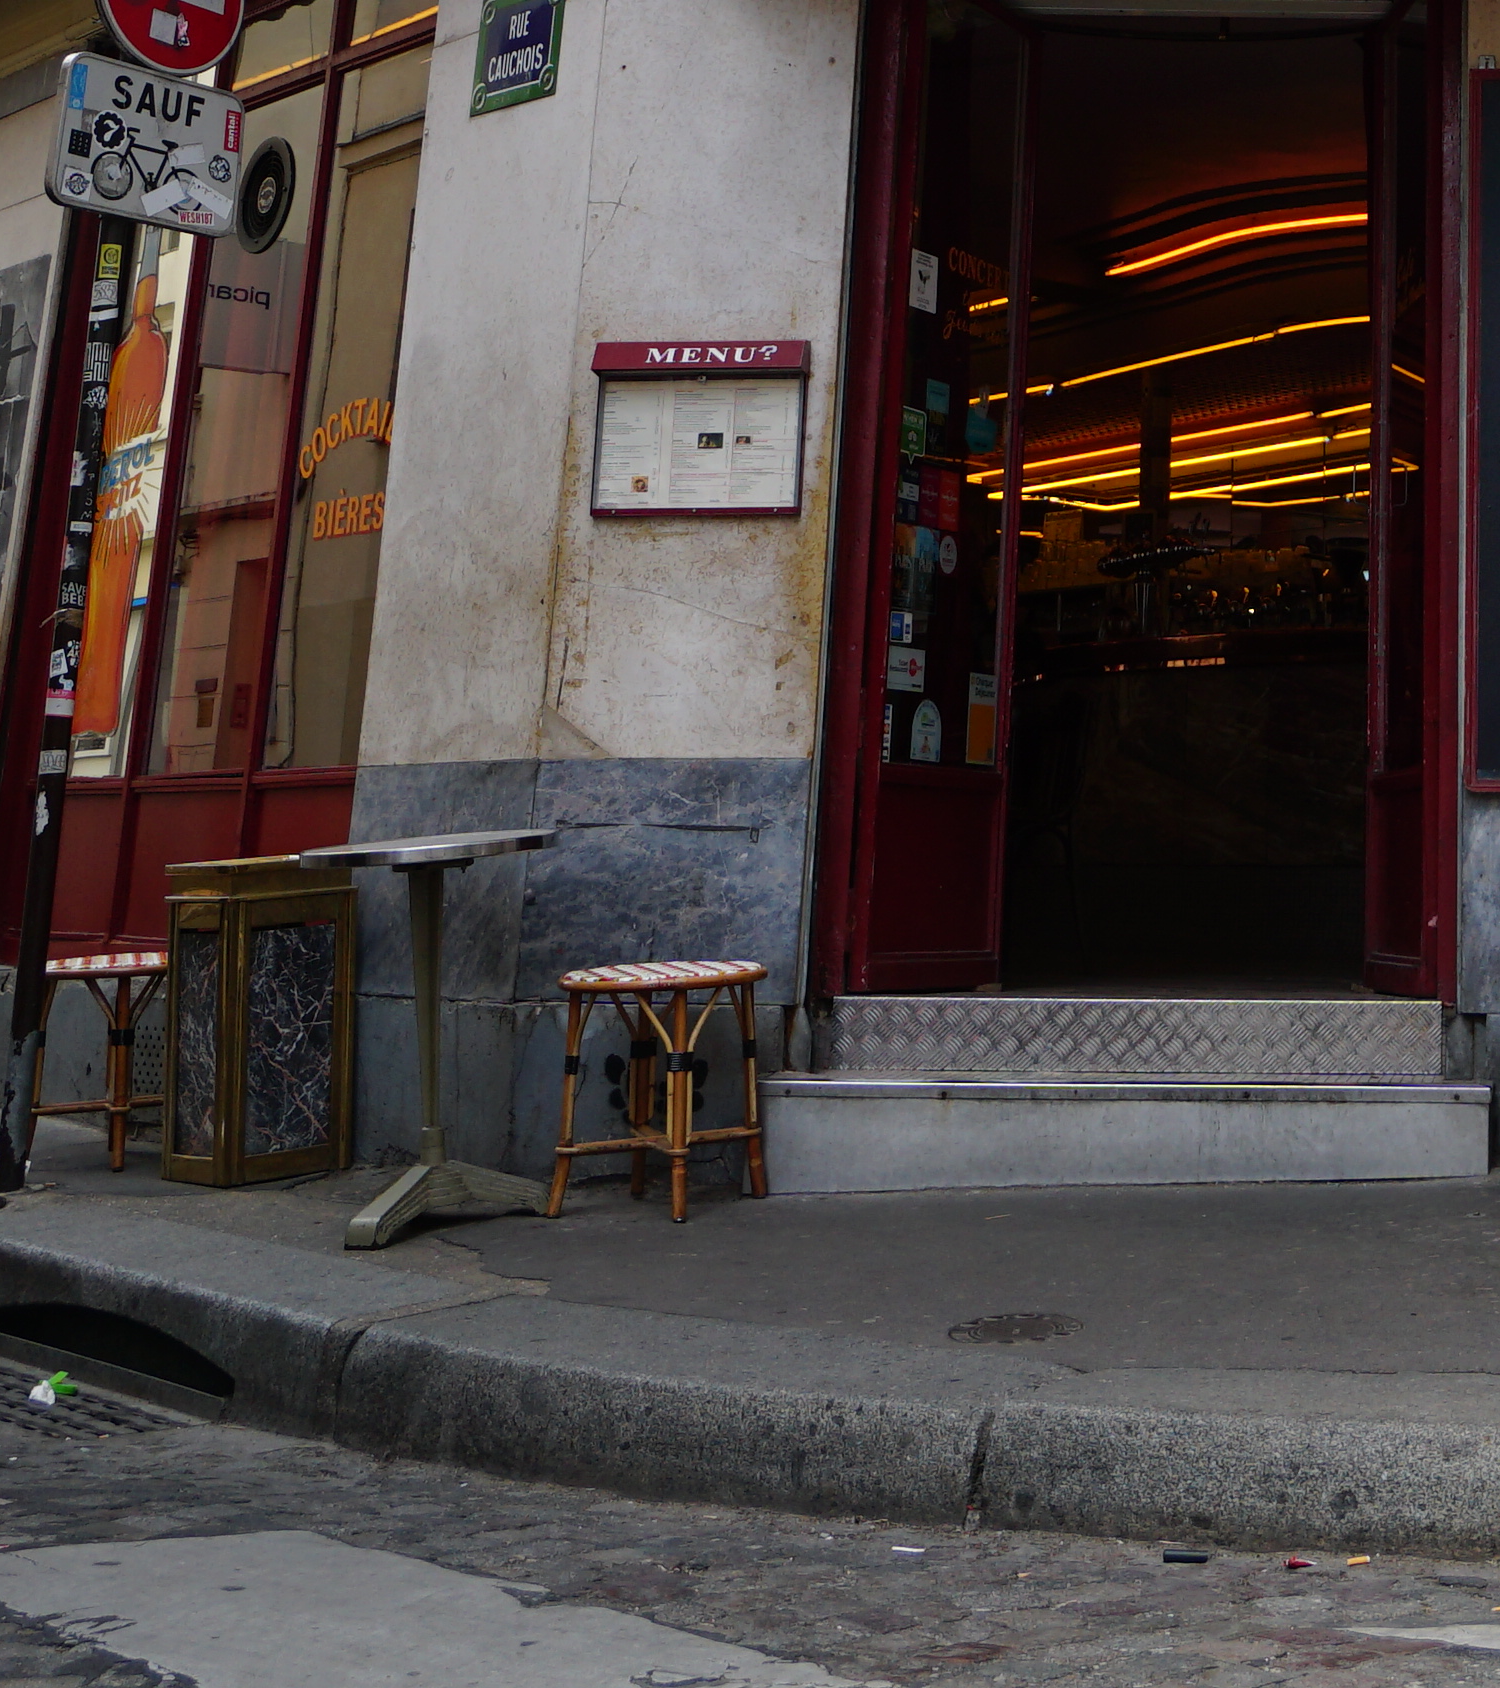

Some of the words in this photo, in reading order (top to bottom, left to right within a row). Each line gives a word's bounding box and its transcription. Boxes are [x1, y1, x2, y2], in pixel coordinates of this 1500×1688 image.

[509, 10, 530, 40] RUE
[488, 44, 543, 83] CAUCHOIS
[111, 75, 206, 127] SAUF
[645, 345, 778, 363] MENU?
[313, 488, 385, 540] BIÈRES
